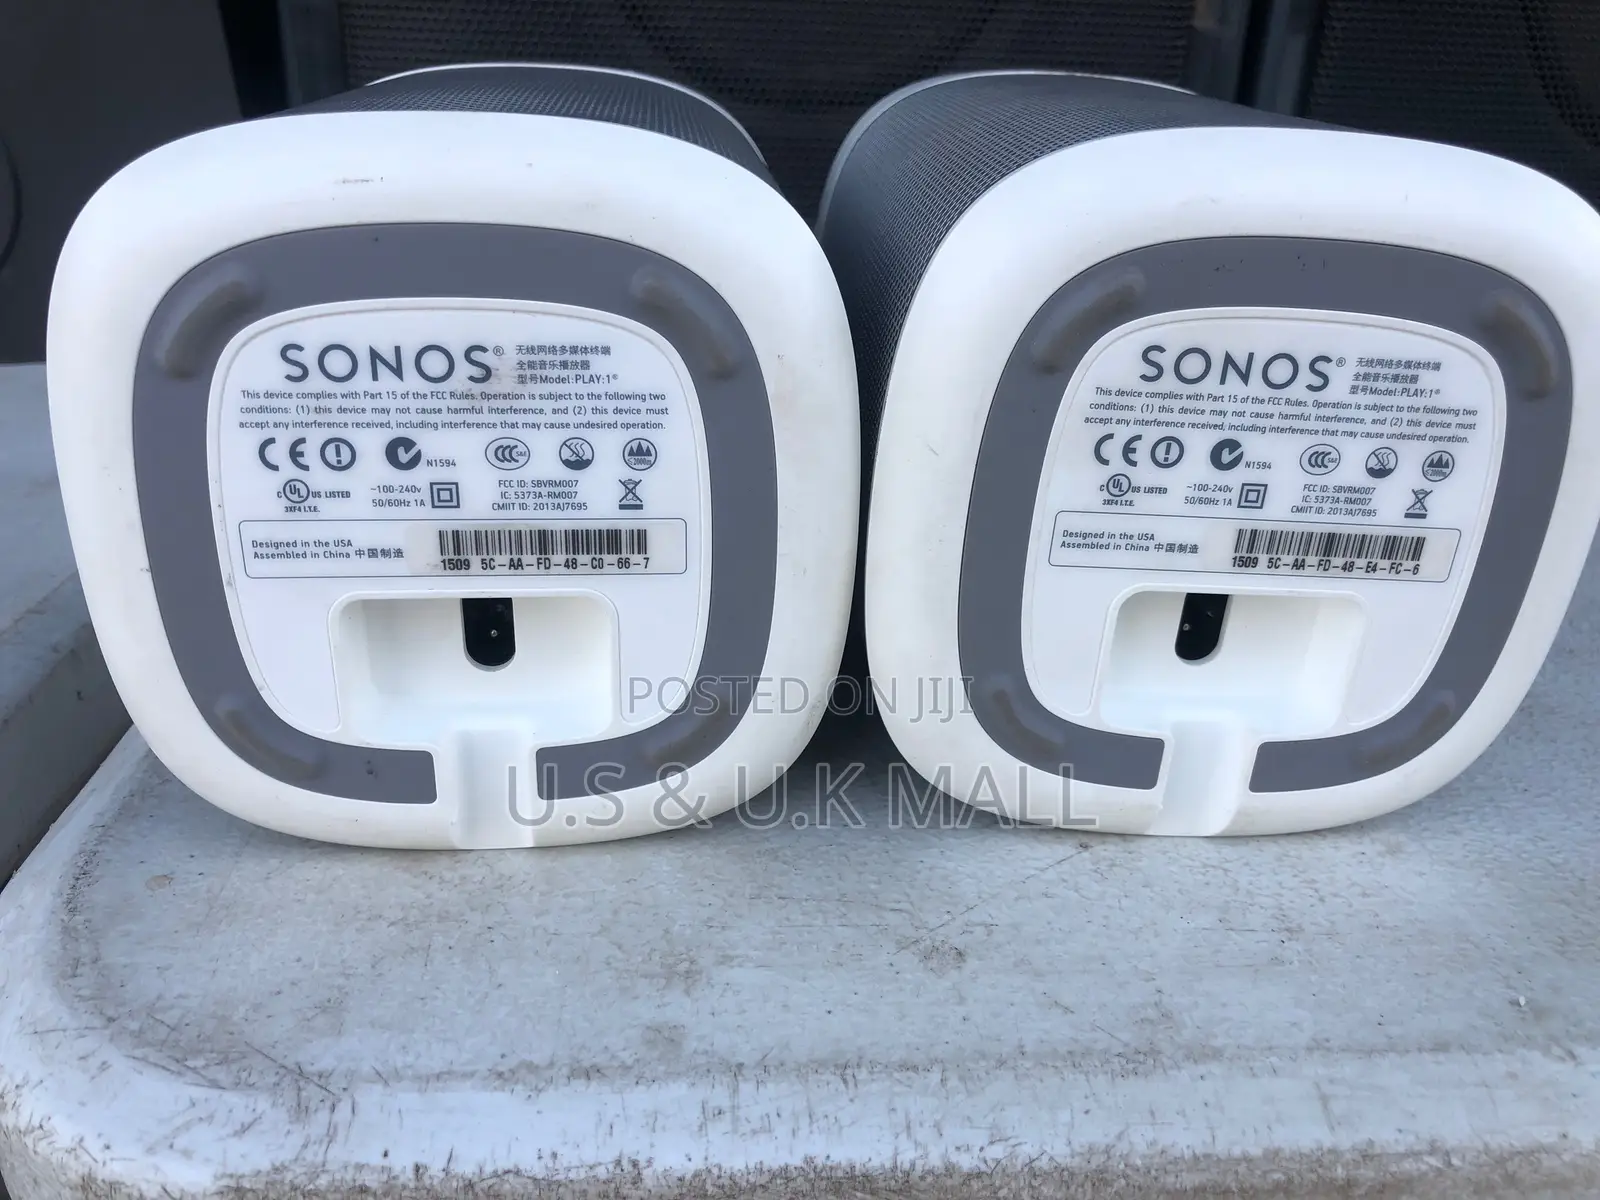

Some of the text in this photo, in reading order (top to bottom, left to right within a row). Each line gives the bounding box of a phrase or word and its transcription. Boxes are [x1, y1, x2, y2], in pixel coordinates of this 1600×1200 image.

[515, 345, 611, 356] 无线网络多媒体终端
[516, 360, 591, 370] 全能音乐播放器
[241, 390, 261, 399] This
[263, 390, 293, 399] device
[295, 391, 338, 401] complies
[340, 391, 361, 399] with
[363, 391, 383, 399] Part
[386, 391, 397, 400] 15
[400, 391, 410, 399] of
[412, 391, 428, 399] the
[430, 391, 447, 400] FCC
[449, 390, 478, 400] Rules.
[480, 391, 526, 402] Operation
[528, 392, 536, 400] is
[538, 392, 573, 402] subject
[587, 392, 602, 400] the
[604, 392, 647, 402] following
[1095, 387, 1112, 396] This
[1114, 388, 1143, 397] device
[1145, 391, 1184, 401] complies
[1185, 393, 1204, 401] with
[1206, 393, 1225, 402] Part
[1227, 395, 1238, 403] 15
[1251, 396, 1266, 404] the
[1267, 397, 1283, 405] FCC
[1284, 398, 1310, 407] Rules.
[1311, 400, 1352, 410] Operation
[1354, 402, 1361, 410] is
[1363, 403, 1394, 413] subject
[1406, 405, 1420, 413] the
[1422, 405, 1461, 417] following
[240, 405, 292, 414] conditions:
[295, 405, 310, 415] (1)
[314, 405, 333, 414] this
[336, 405, 367, 414] device
[371, 408, 391, 416] may
[447, 406, 484, 414] harmful
[488, 406, 547, 415] interference,
[551, 406, 569, 414] and
[572, 405, 587, 416] (2)
[590, 406, 608, 414] this
[612, 406, 641, 414] device
[1089, 402, 1137, 411] conditions:
[1140, 403, 1154, 414] (1)
[1158, 405, 1174, 413] this
[1178, 406, 1206, 415] device
[1209, 410, 1228, 418] may
[1277, 412, 1311, 421] harmful
[1314, 414, 1367, 424] interference,
[1370, 417, 1387, 425] and
[1389, 417, 1403, 427] (2)
[1406, 419, 1422, 427] this
[1425, 420, 1452, 428] device
[239, 420, 271, 430] accept
[272, 422, 290, 430] any
[292, 420, 349, 428] interference
[351, 420, 393, 429] received,
[395, 420, 439, 430] including
[440, 420, 498, 429] interference
[500, 420, 519, 429] that
[521, 423, 542, 431] may
[573, 420, 618, 429] undesired
[620, 421, 666, 431] operation.
[1084, 417, 1113, 426] accept
[1115, 419, 1132, 427] any
[1133, 418, 1185, 428] interference
[1187, 422, 1226, 431] received,
[1228, 423, 1267, 434] including
[1268, 425, 1320, 435] interference
[1321, 428, 1339, 436] that
[1340, 431, 1359, 439] may
[1386, 432, 1427, 441] undesired
[1428, 435, 1470, 443] operation.
[426, 459, 456, 467] N1594
[1244, 461, 1272, 470] N1594
[498, 480, 579, 488] FCC ID: SBVRM007
[1303, 484, 1376, 495] FCC ID: SBVRM007
[500, 491, 578, 499] IC: 5373A-RM007
[1313, 494, 1372, 505] 5373A-RM007
[371, 499, 412, 508] 50/60Hz
[533, 502, 588, 511] 2013AJ7695
[1184, 496, 1232, 506] 50/60Hz 1A
[1291, 505, 1314, 513] CMIIT
[1327, 507, 1377, 517] 2013AJ7695
[1062, 530, 1105, 540] Designed
[1119, 532, 1134, 540] the
[1137, 533, 1155, 541] USA
[251, 540, 298, 550] Designed
[300, 540, 310, 548] in
[1060, 539, 1110, 550] Assembled
[1124, 543, 1150, 551] China
[1153, 543, 1199, 554] 中国制造
[253, 549, 307, 559] Assembled
[354, 548, 404, 559] 中国制造
[440, 558, 471, 570] 1509
[1232, 556, 1259, 568] 1509
